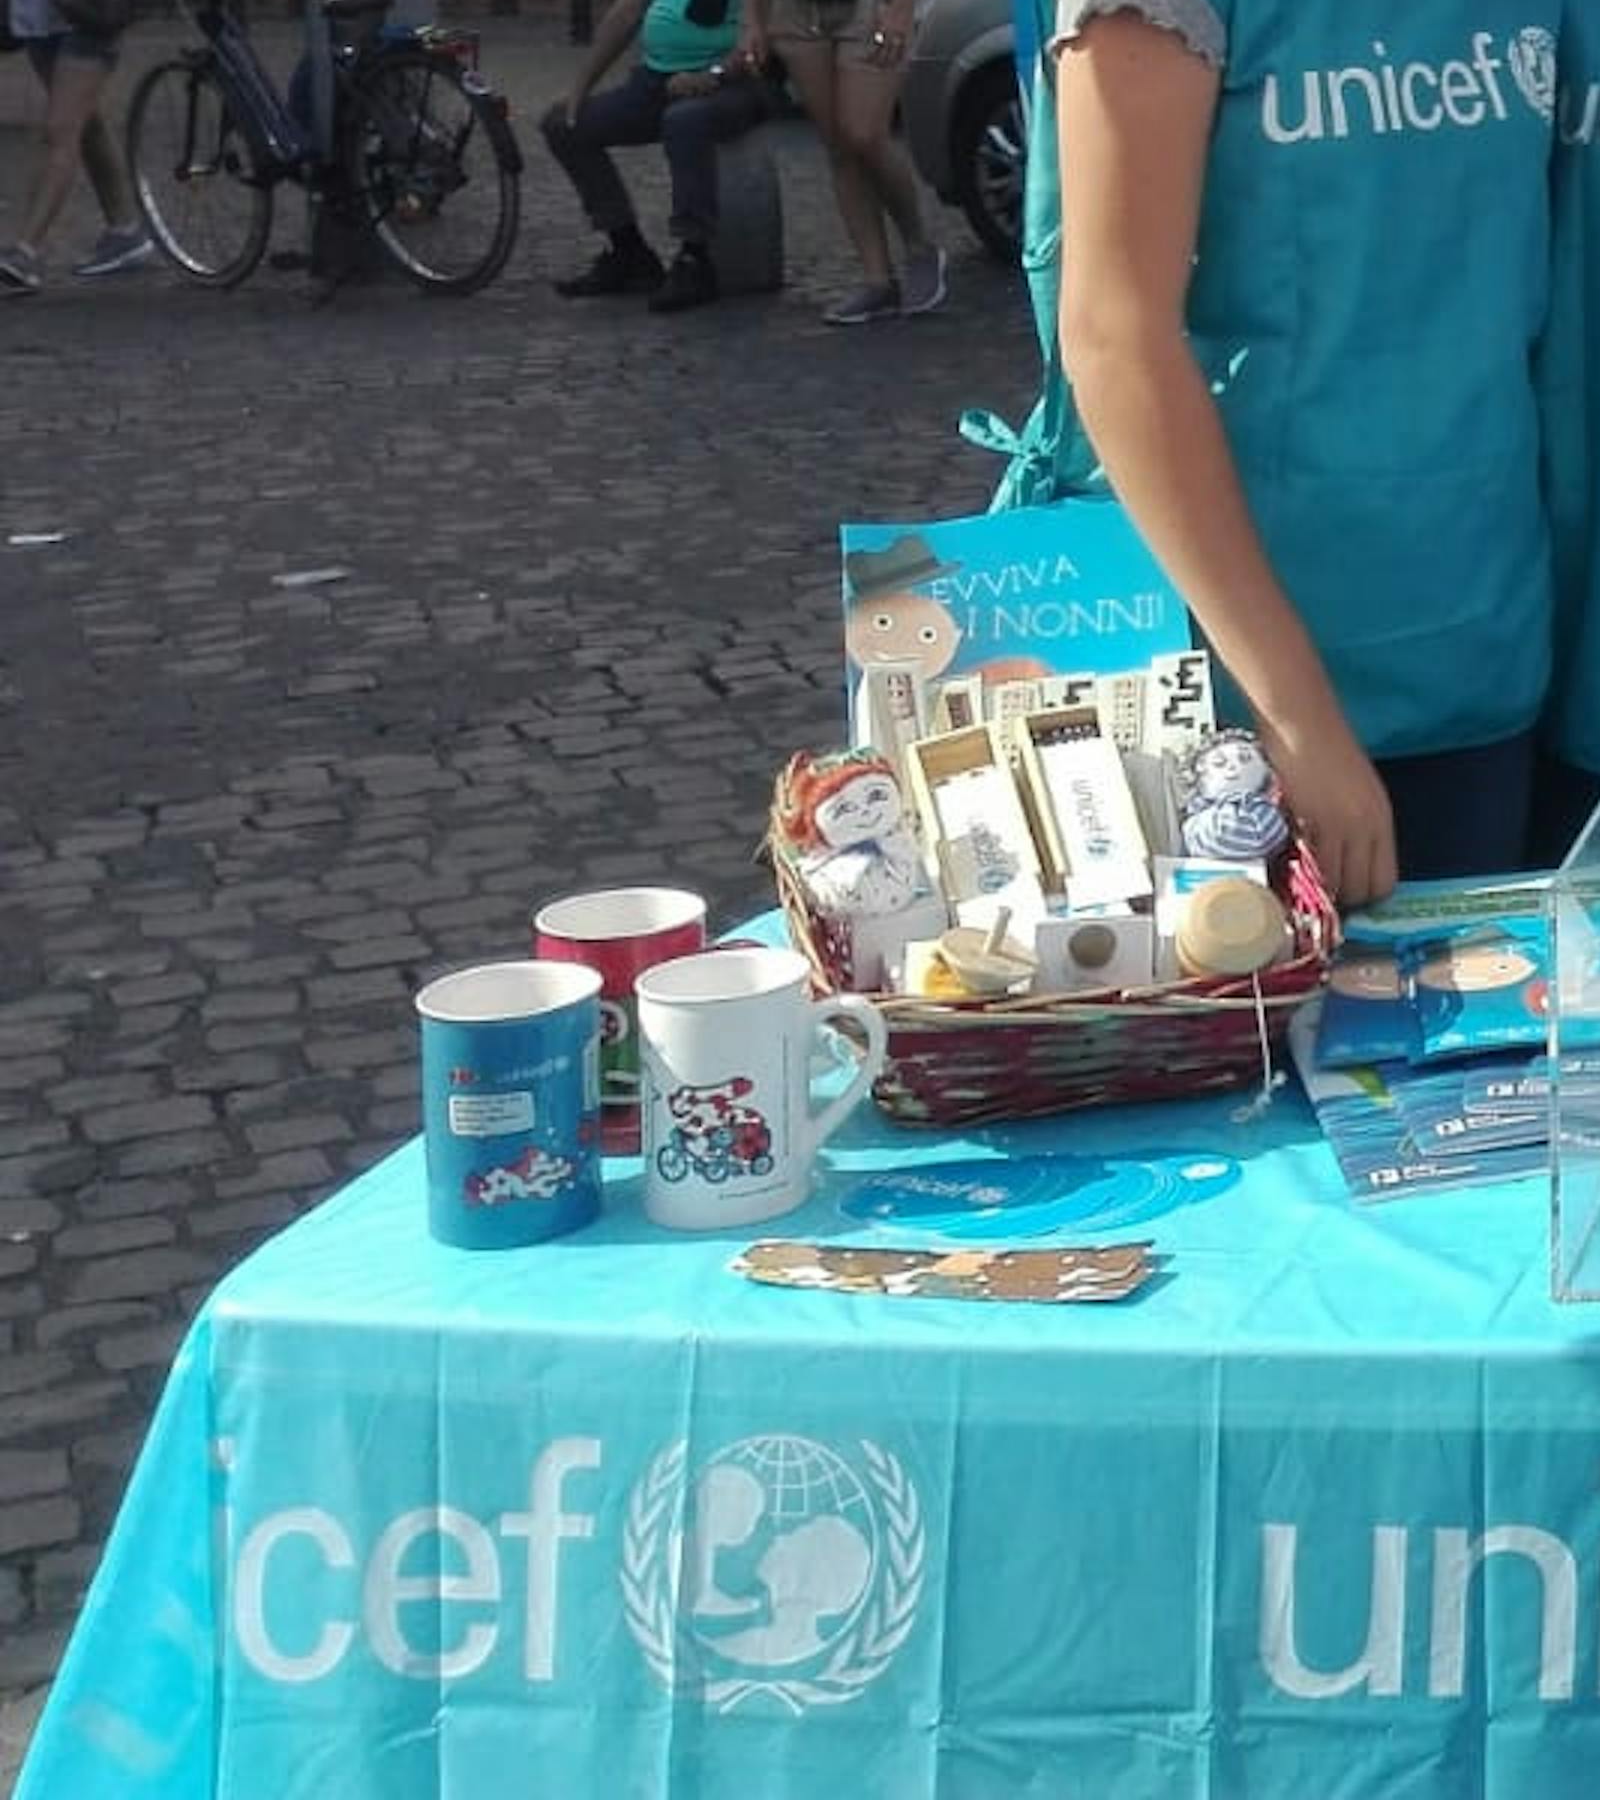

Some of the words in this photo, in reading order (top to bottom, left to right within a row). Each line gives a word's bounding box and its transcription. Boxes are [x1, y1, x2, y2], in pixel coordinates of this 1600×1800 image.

[1261, 31, 1506, 143] unicef
[933, 554, 1080, 604] EVVIVA
[216, 1435, 602, 1683] cef
